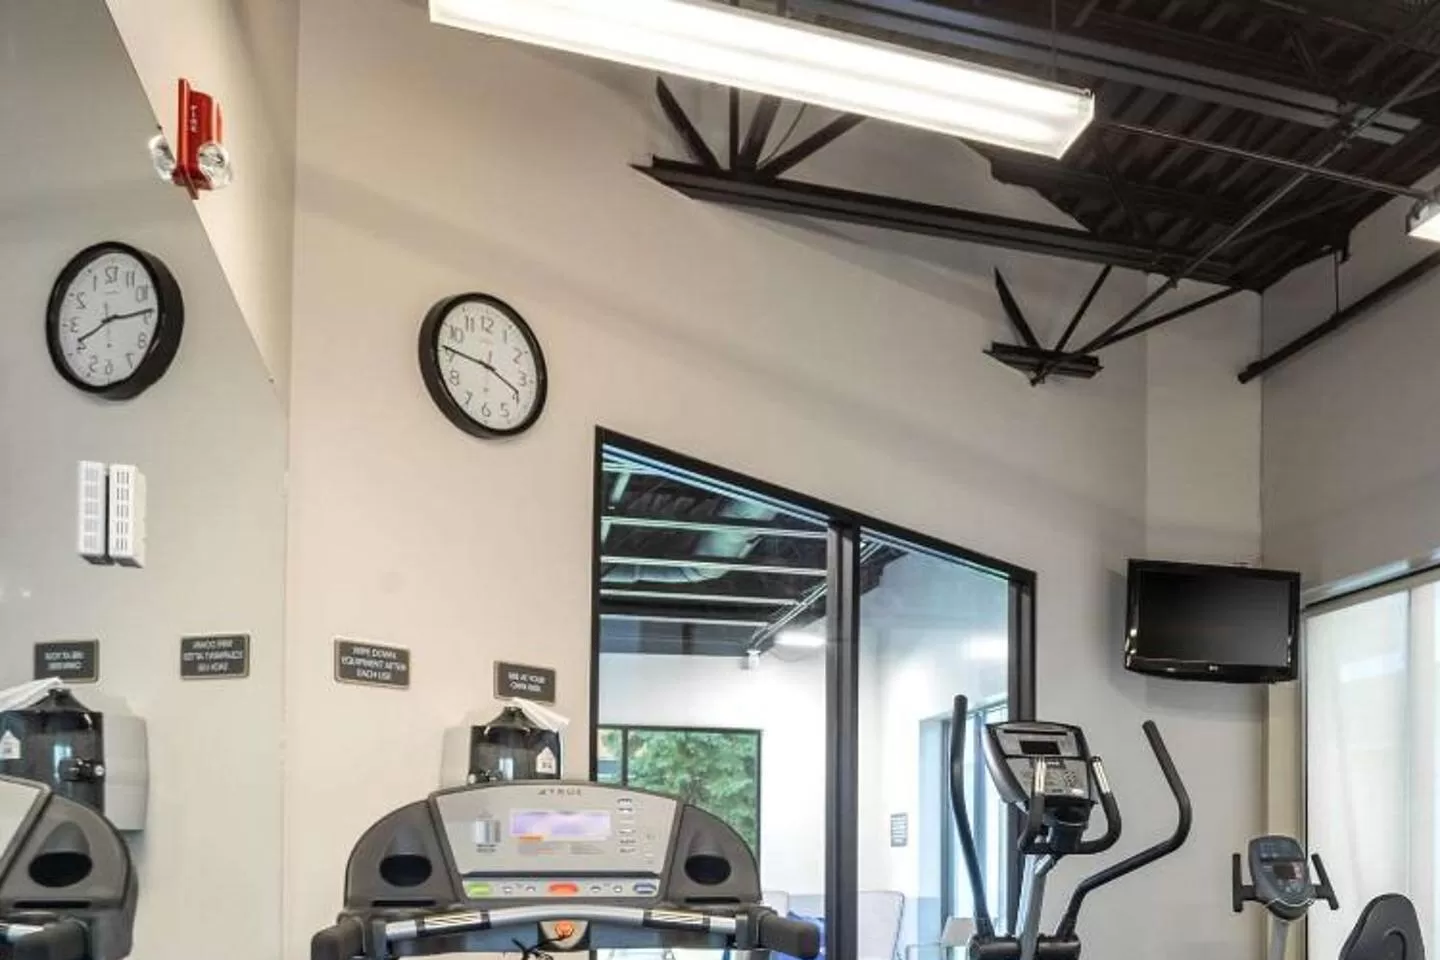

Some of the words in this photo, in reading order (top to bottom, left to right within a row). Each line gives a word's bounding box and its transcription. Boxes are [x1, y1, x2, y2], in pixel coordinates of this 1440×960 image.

[464, 315, 476, 333] 11
[480, 315, 495, 335] 12
[511, 347, 523, 365] 2
[448, 367, 460, 387] 8
[518, 370, 528, 388] 3
[480, 402, 492, 418] 6
[499, 402, 511, 418] 5
